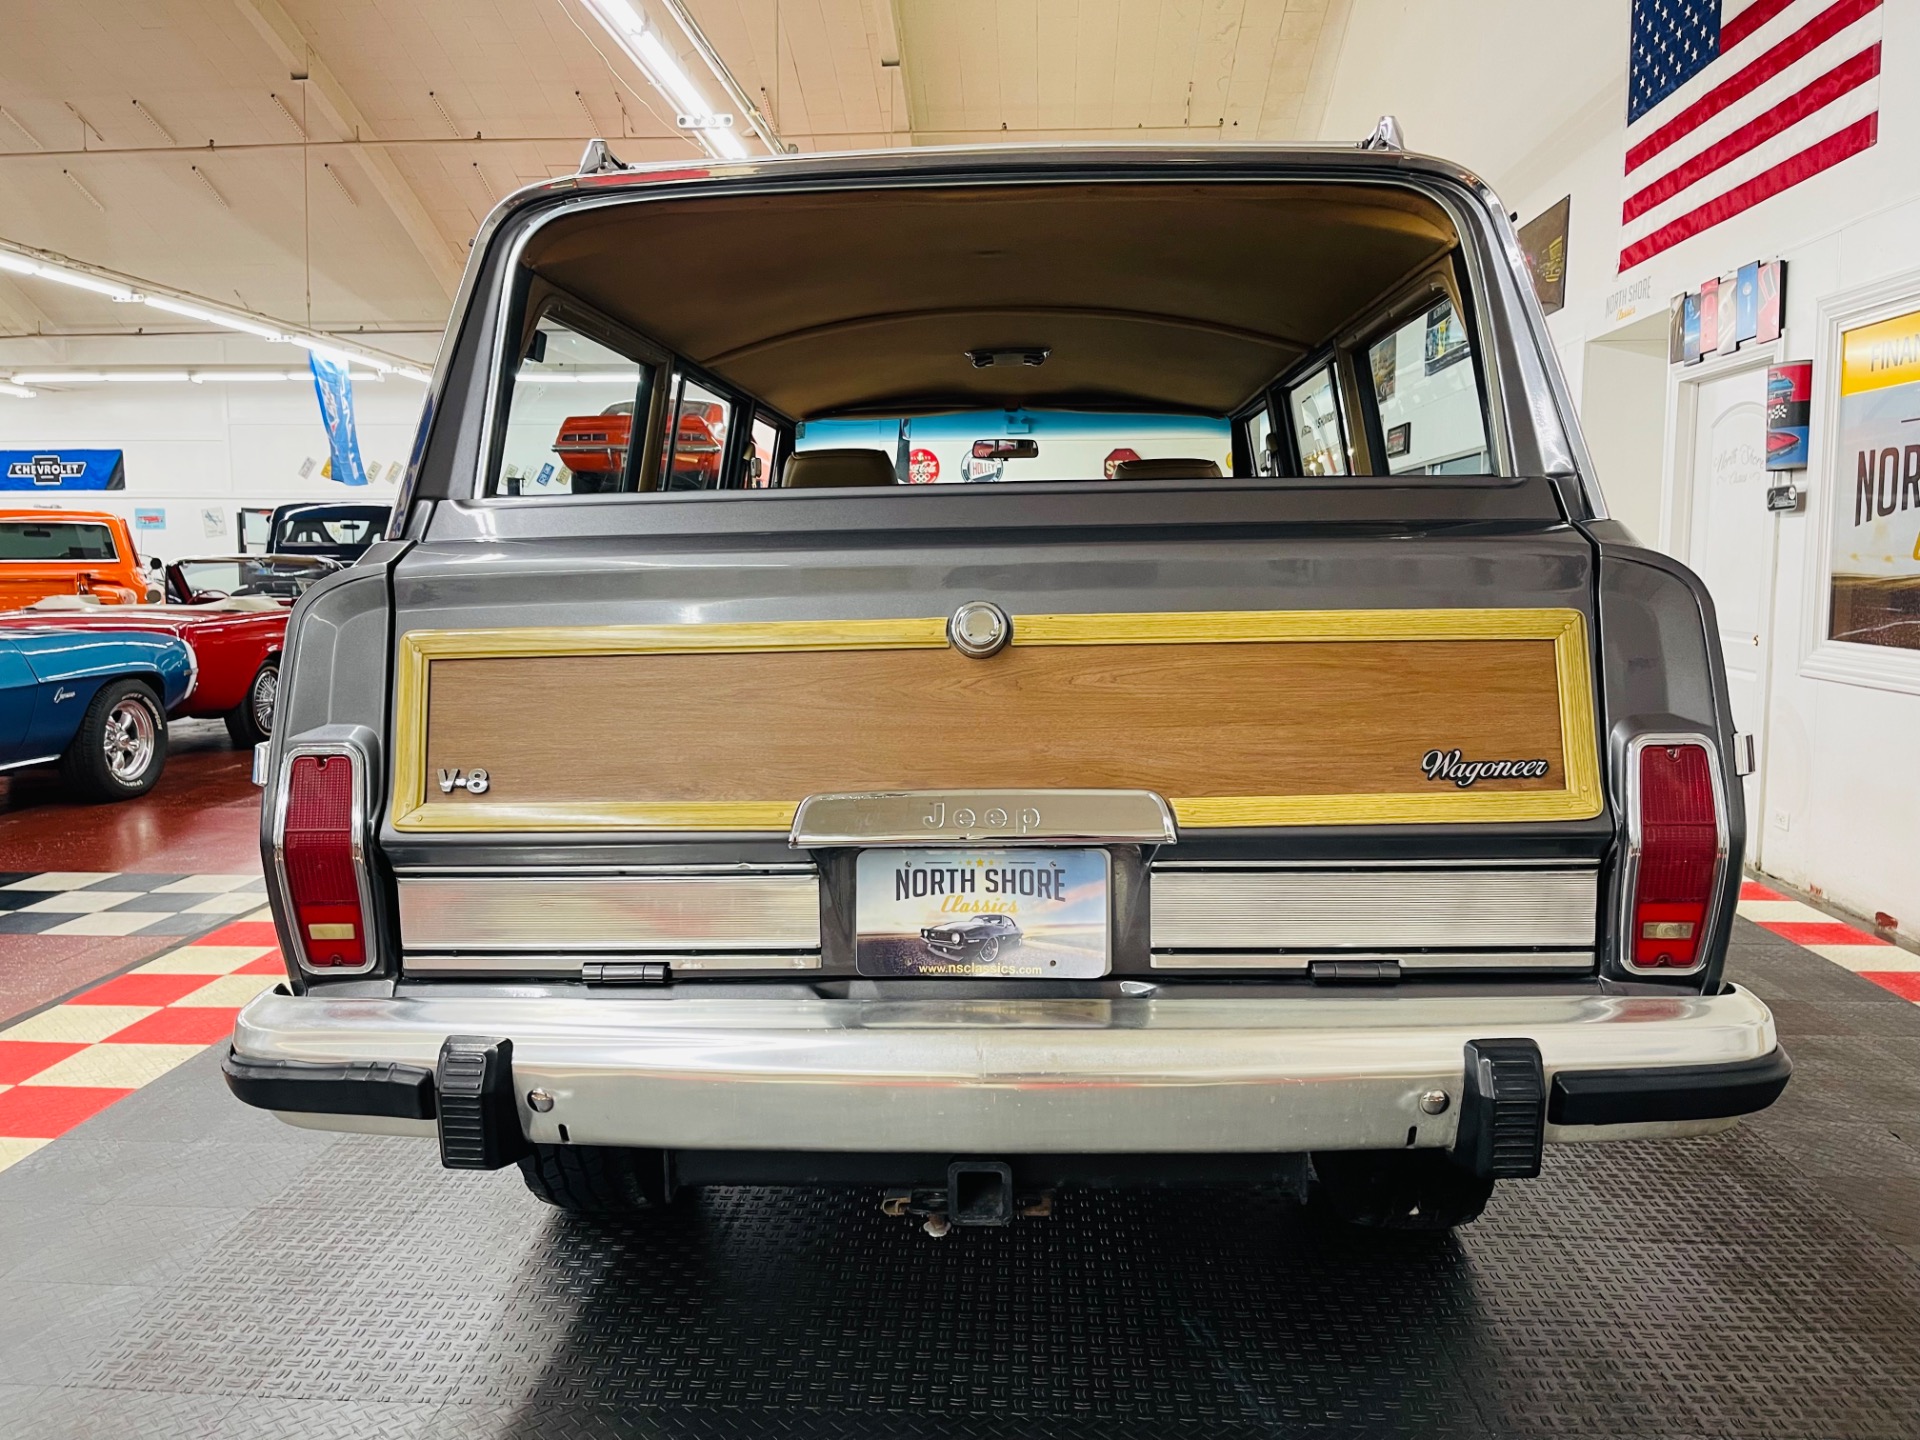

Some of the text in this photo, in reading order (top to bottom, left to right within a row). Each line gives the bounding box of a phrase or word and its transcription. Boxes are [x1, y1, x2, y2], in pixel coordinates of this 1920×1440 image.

[1605, 275, 1652, 319] NORTH SHORE
[14, 463, 79, 476] CHEVROLET
[972, 460, 996, 476] HOLLEY
[436, 767, 490, 794] V-8
[1421, 748, 1549, 788] Wagoneer
[922, 802, 1041, 834] Jeep
[895, 868, 1067, 902] NORTH SHORE
[940, 893, 1019, 914] Classics
[918, 962, 1042, 976] www.nsclassics.com
